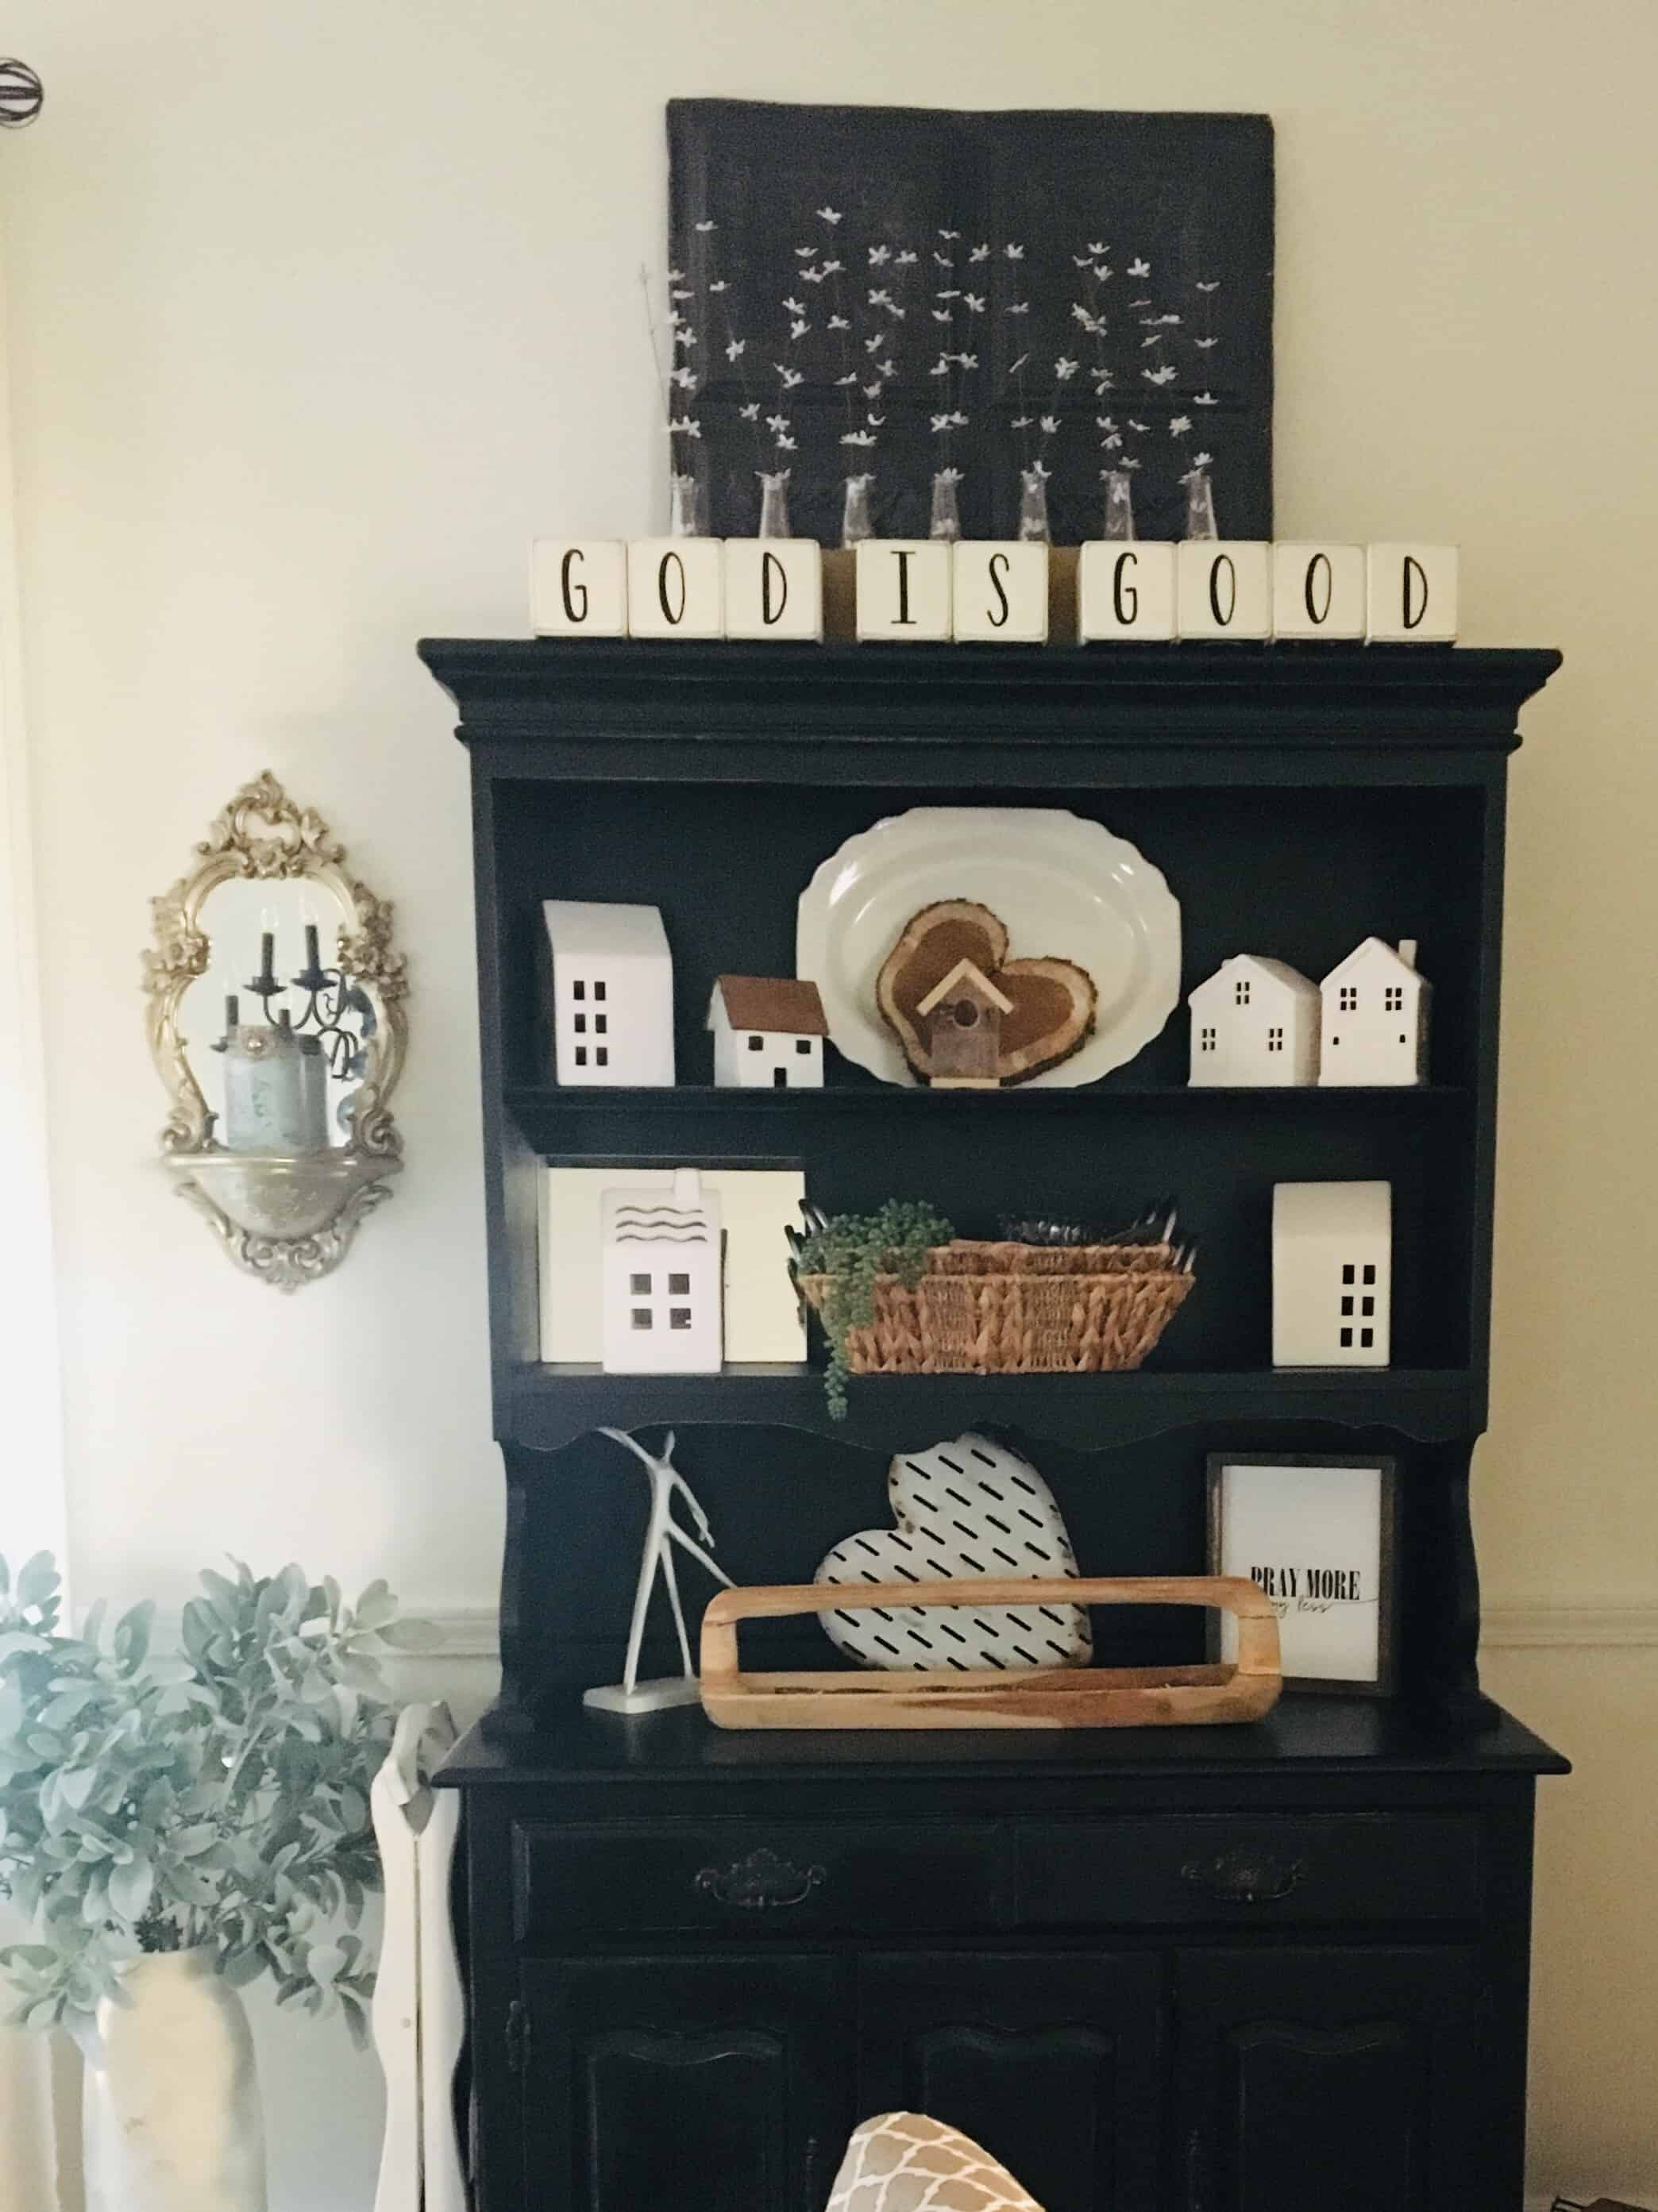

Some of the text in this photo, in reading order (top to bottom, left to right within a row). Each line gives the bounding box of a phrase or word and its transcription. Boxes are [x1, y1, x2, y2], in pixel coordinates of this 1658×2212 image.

[561, 549, 1429, 630] GOD IS GOOD
[1306, 1568, 1361, 1601] MORE
[1297, 1594, 1335, 1614] less
